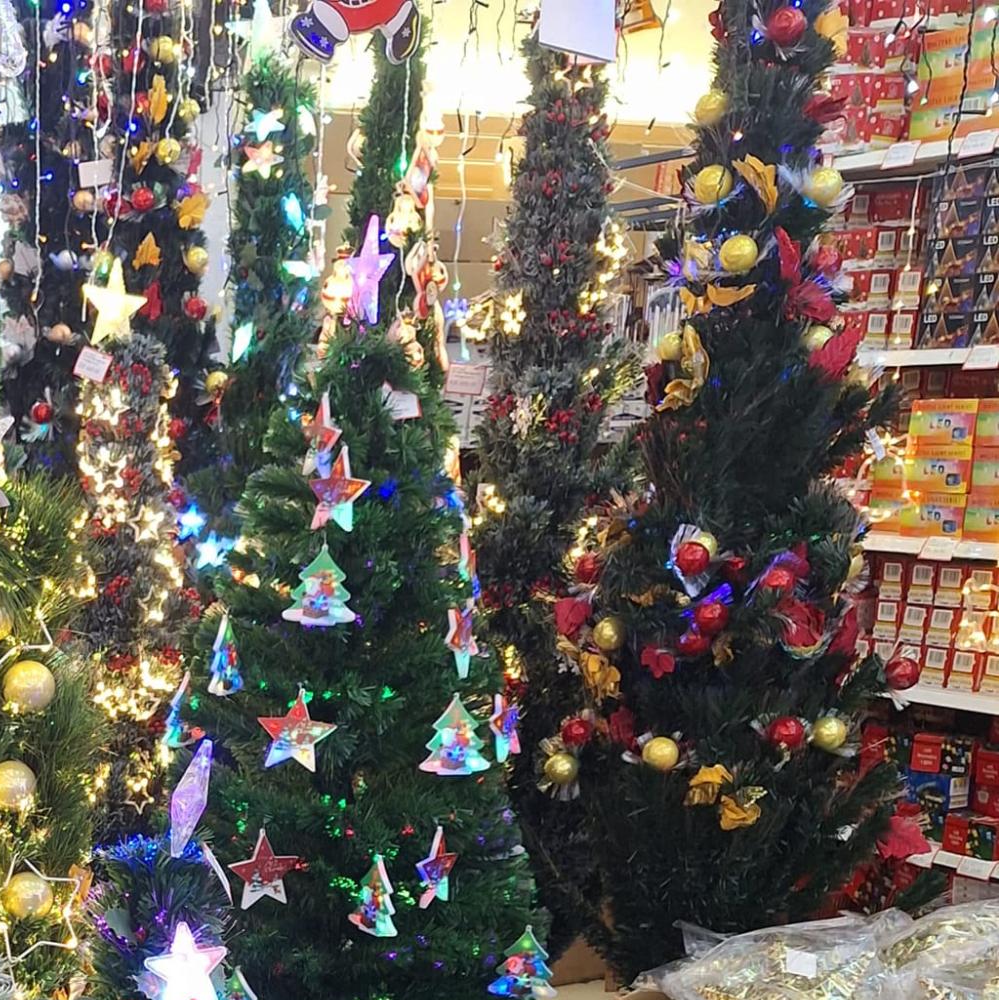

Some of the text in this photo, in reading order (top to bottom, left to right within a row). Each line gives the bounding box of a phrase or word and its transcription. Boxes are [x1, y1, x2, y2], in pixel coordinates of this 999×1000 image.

[980, 274, 995, 284] LED
[923, 314, 938, 324] LED
[973, 312, 989, 323] LED
